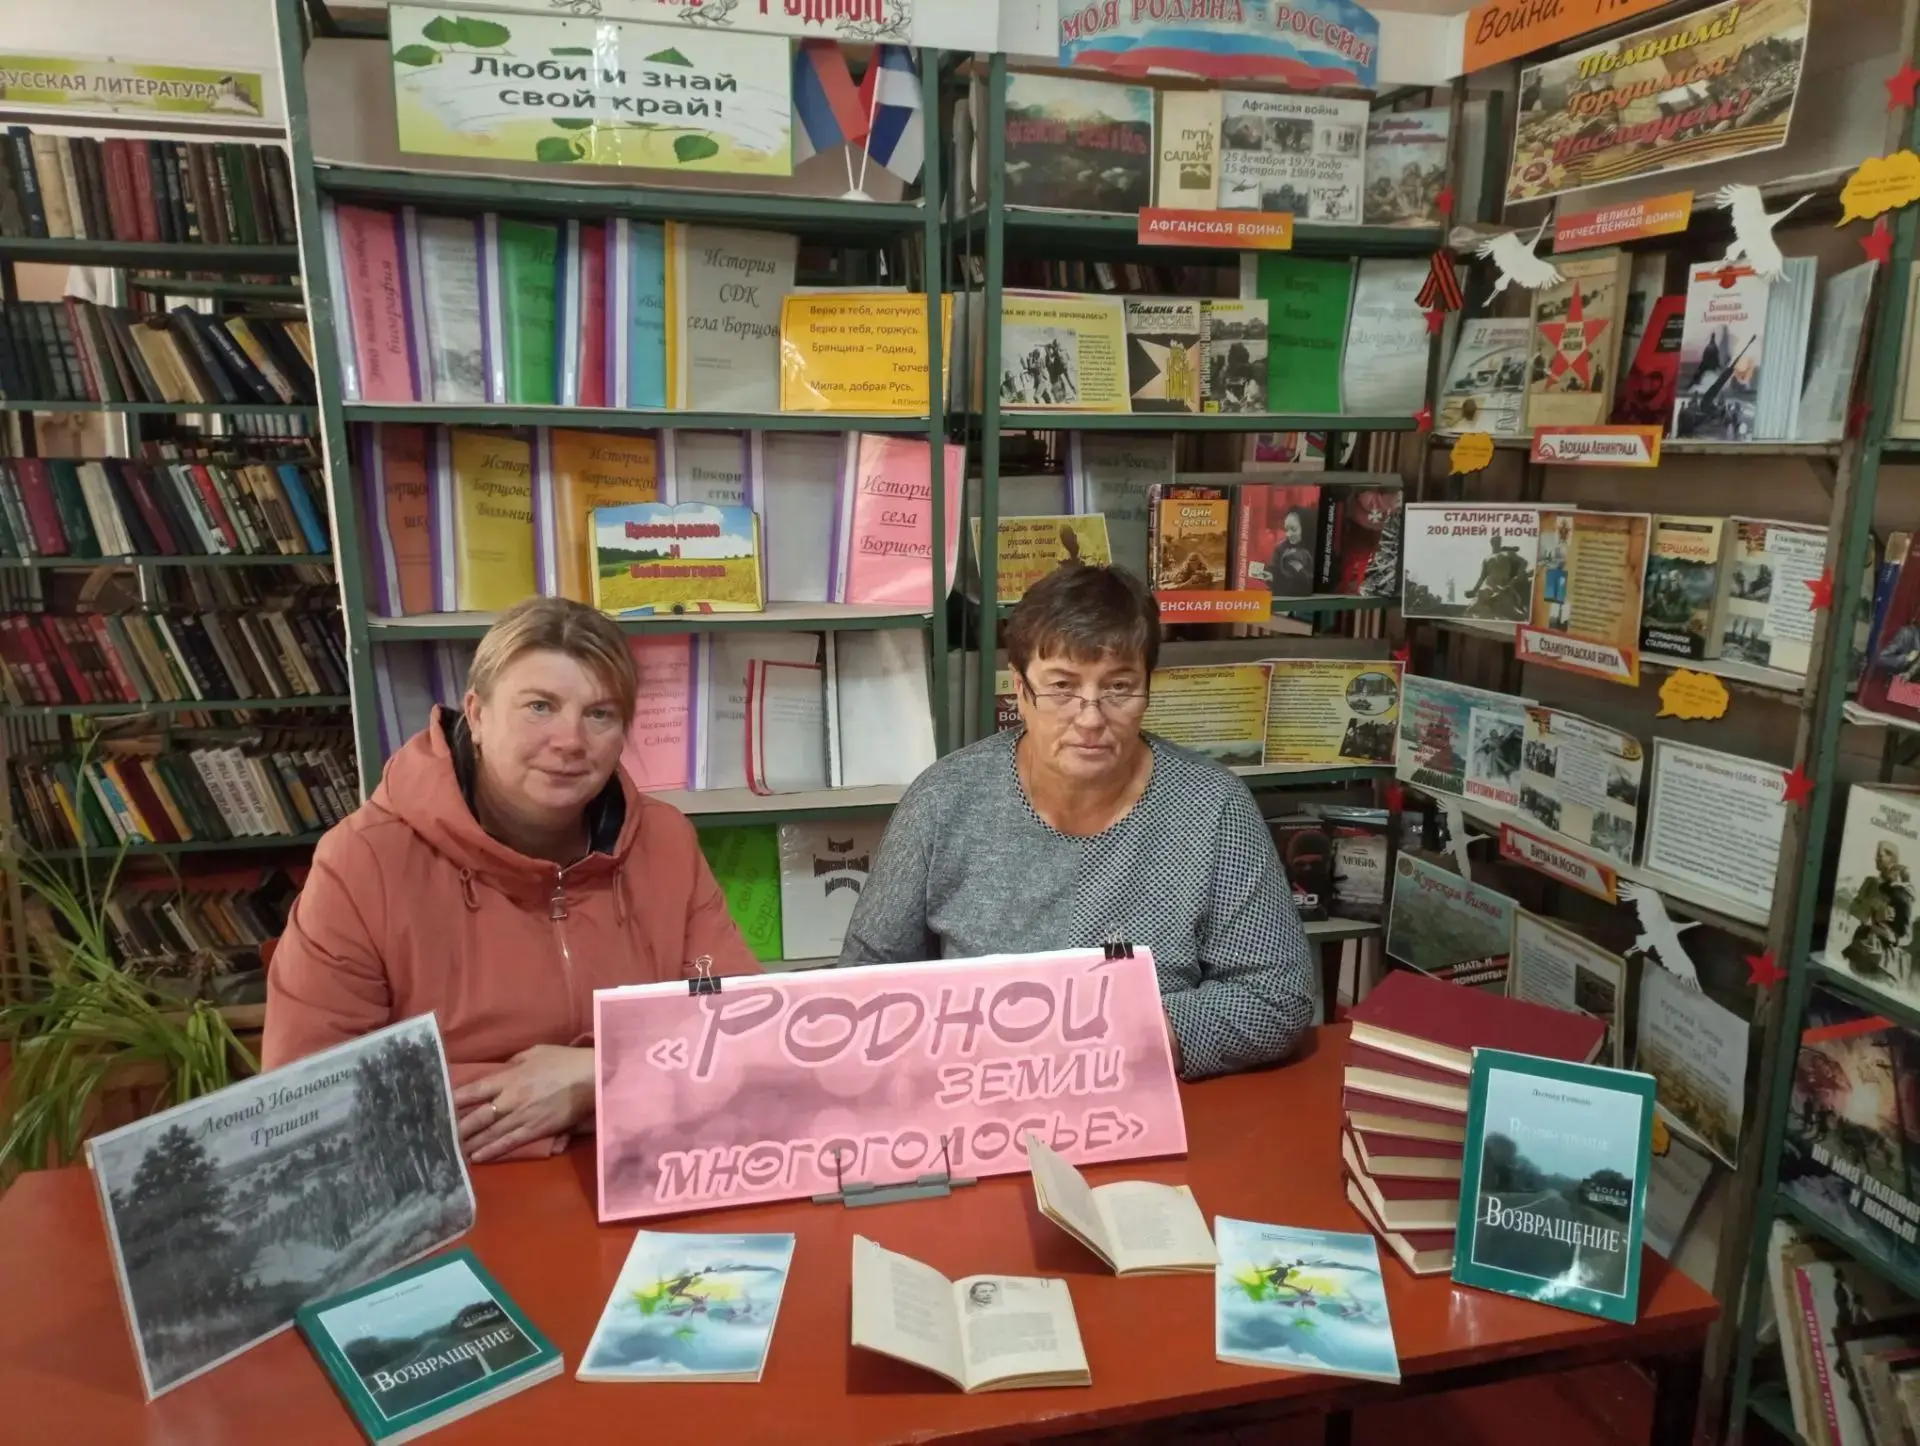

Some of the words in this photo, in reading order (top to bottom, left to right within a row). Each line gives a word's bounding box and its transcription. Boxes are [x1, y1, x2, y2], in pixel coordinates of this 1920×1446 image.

[1060, 0, 1120, 45] МОЯ
[1131, 0, 1245, 23] РОДИНА
[1276, 6, 1373, 67] РОССИЯ
[1577, 7, 1741, 81] Помним!
[0, 70, 87, 91] РУССКАЯ
[93, 76, 221, 100] ЛИТЕРАТУРА
[469, 56, 587, 84] Люби
[602, 70, 627, 86] и
[642, 71, 737, 93] знай
[1566, 45, 1745, 120] Гордимся!
[499, 89, 596, 109] свой
[612, 91, 722, 118] край!
[1242, 99, 1302, 114] Афганская
[1304, 104, 1339, 116] война
[1181, 129, 1213, 141] ПУТЬ
[1553, 88, 1752, 162] Наследуем!
[1164, 151, 1212, 162] САЛАНГ
[1196, 141, 1213, 151] НА
[1241, 153, 1286, 167] декабря
[1289, 156, 1315, 168] 1979
[1596, 203, 1645, 224] ВЕЛИКАЯ
[1149, 218, 1233, 234] АФГАНСКАЯ
[1237, 222, 1285, 235] ВОЙНА
[1558, 215, 1643, 241] ОТЕЧЕСТВЕННАЯ
[1644, 208, 1685, 228] ВОЙНА
[704, 248, 776, 277] История
[719, 283, 760, 308] СДК
[810, 305, 837, 317] Верю
[1001, 309, 1014, 317] ак
[687, 316, 718, 331] села
[722, 316, 781, 340] Борщов
[810, 324, 837, 335] Верю
[812, 342, 864, 354] Брянщина
[849, 382, 887, 393] добрая
[480, 453, 531, 476] Истор
[471, 479, 532, 498] Борщовс
[862, 475, 933, 499] Истори
[476, 502, 535, 524] Больниц
[880, 508, 918, 527] села
[1180, 506, 1212, 519] Один
[1444, 511, 1534, 525] СТАЛИНГРАД:
[1427, 525, 1449, 536] 200
[1451, 525, 1488, 537] ДНЕЙ
[1491, 526, 1501, 537] И
[1504, 526, 1538, 538] НОЧЕ
[1160, 601, 1212, 612] ЕНСКАЯ
[1215, 600, 1261, 611] ВОЙНА
[1453, 959, 1485, 974] ЗНАТЬ
[941, 1049, 1122, 1103] ЗЕМЛИ
[198, 1097, 267, 1140] Леонид
[267, 1065, 353, 1112] Иванович
[250, 1105, 320, 1147] Гришин
[1485, 1195, 1621, 1254] ВОЗВРАЩЕНИЕ
[373, 1324, 515, 1394] ВОЗВРАЩЕНИЕ
